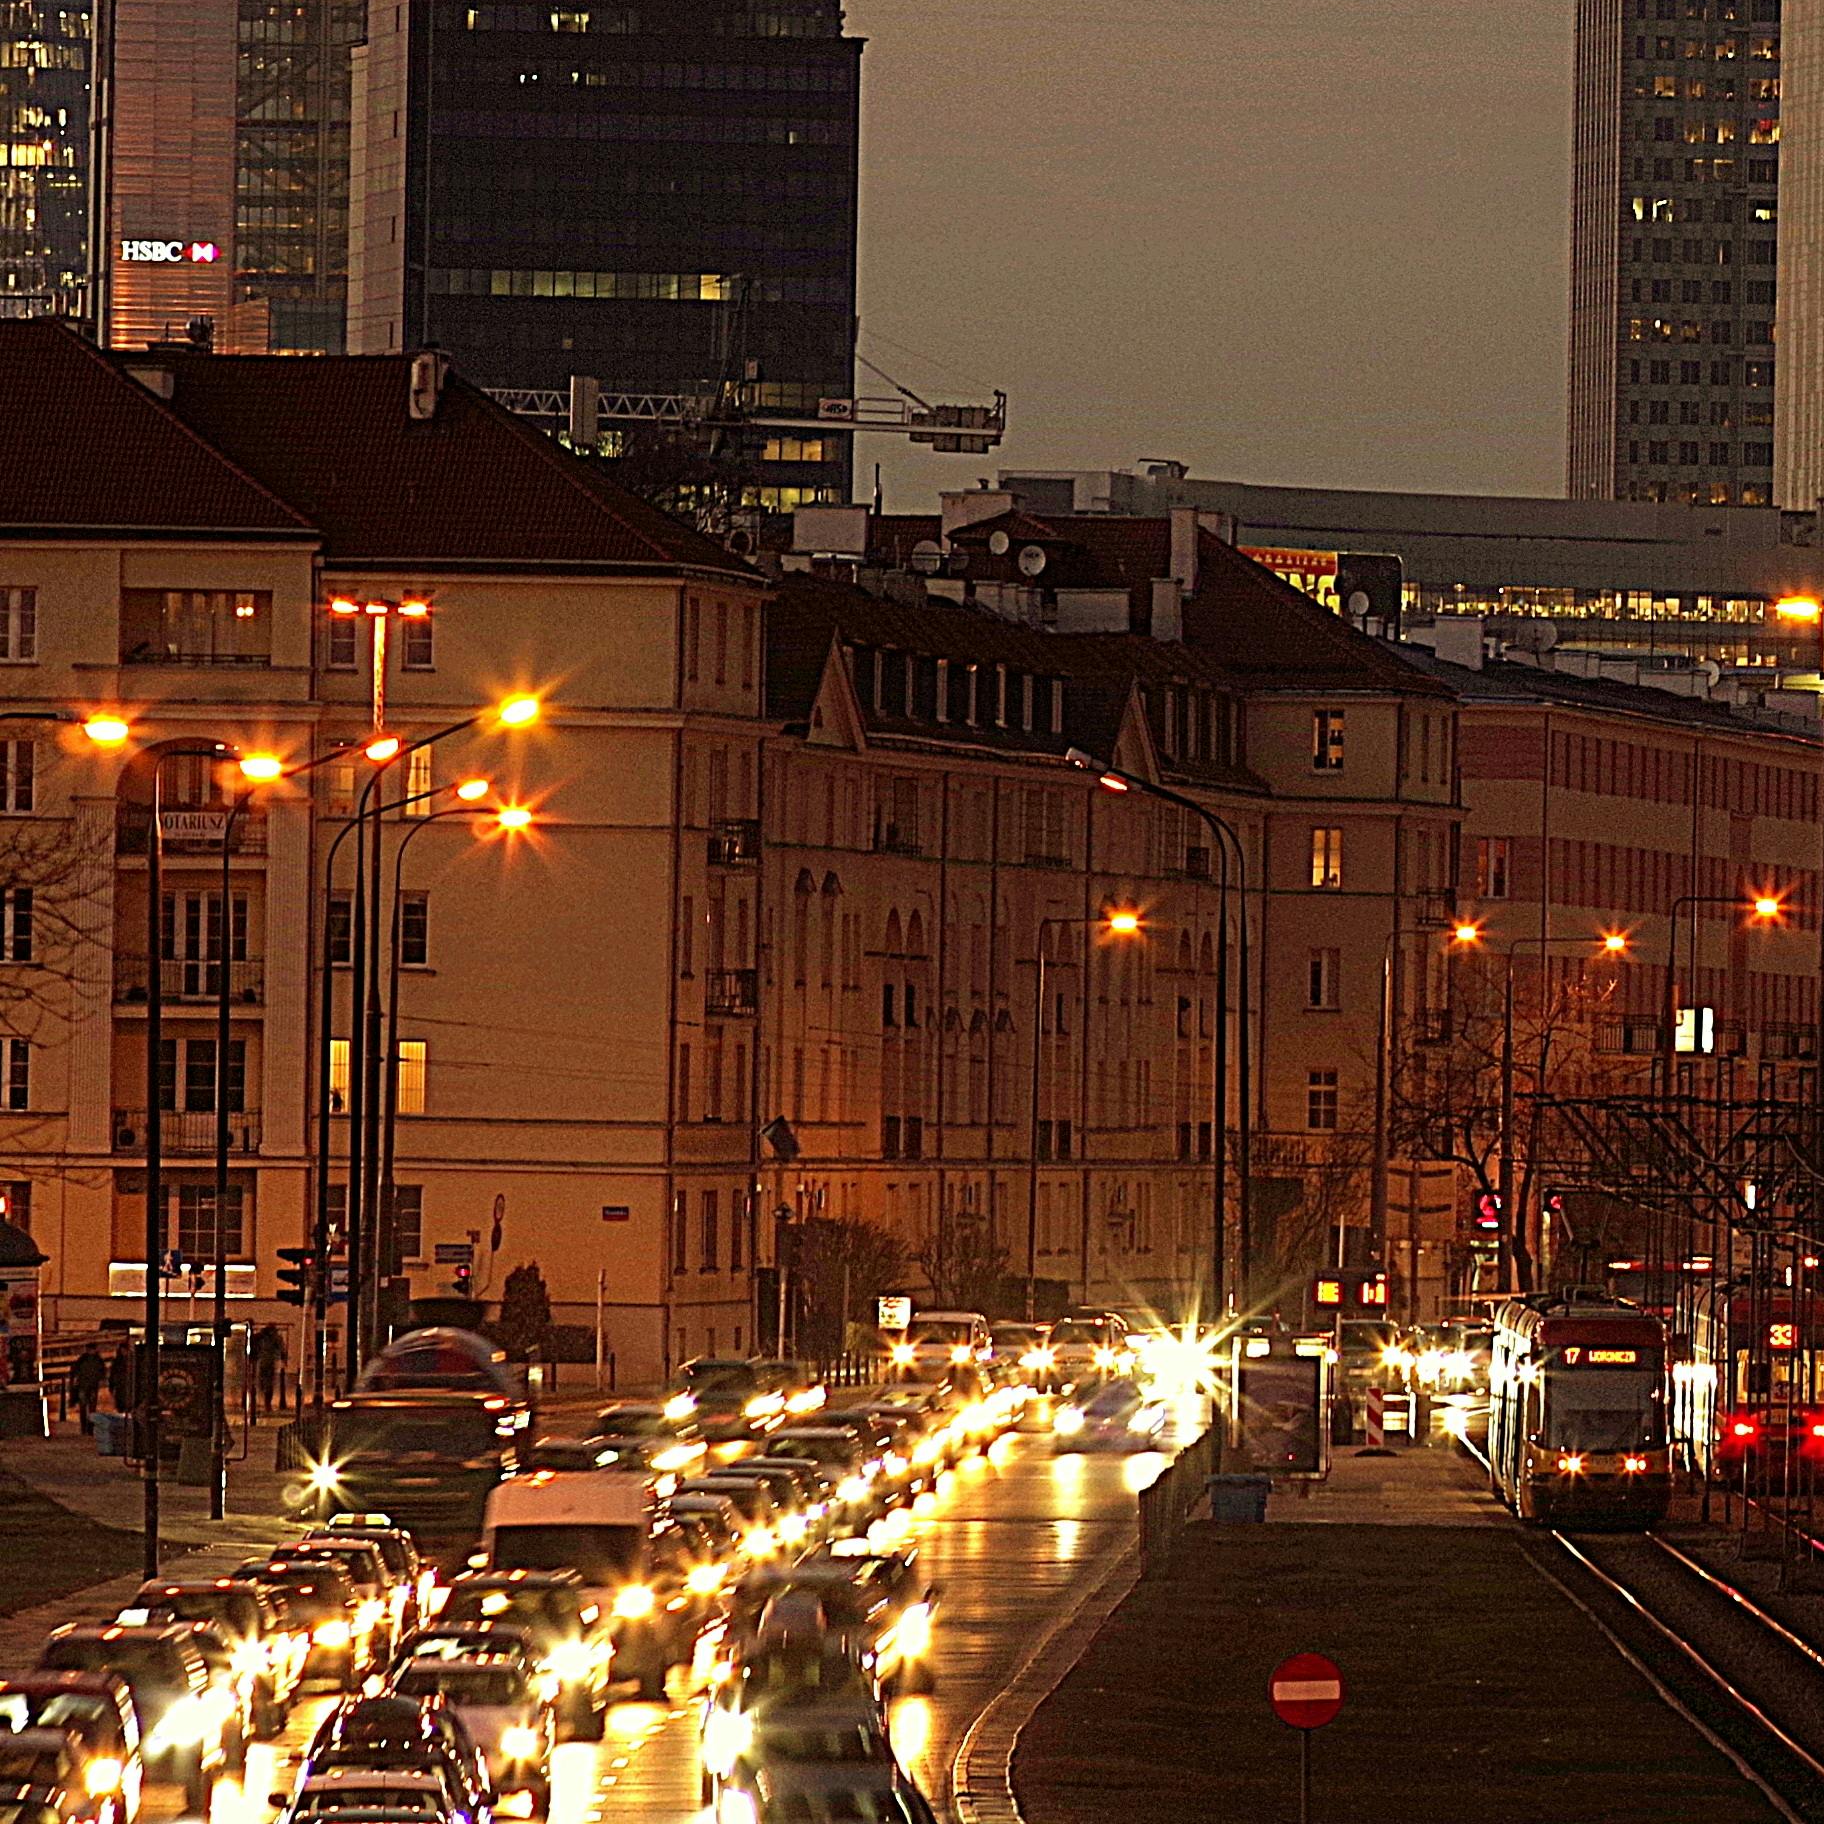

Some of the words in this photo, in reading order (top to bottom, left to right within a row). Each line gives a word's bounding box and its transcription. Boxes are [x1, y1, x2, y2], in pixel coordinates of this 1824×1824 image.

[121, 240, 183, 262] HSBC
[1769, 1323, 1793, 1347] 33
[1564, 1346, 1581, 1365] 17
